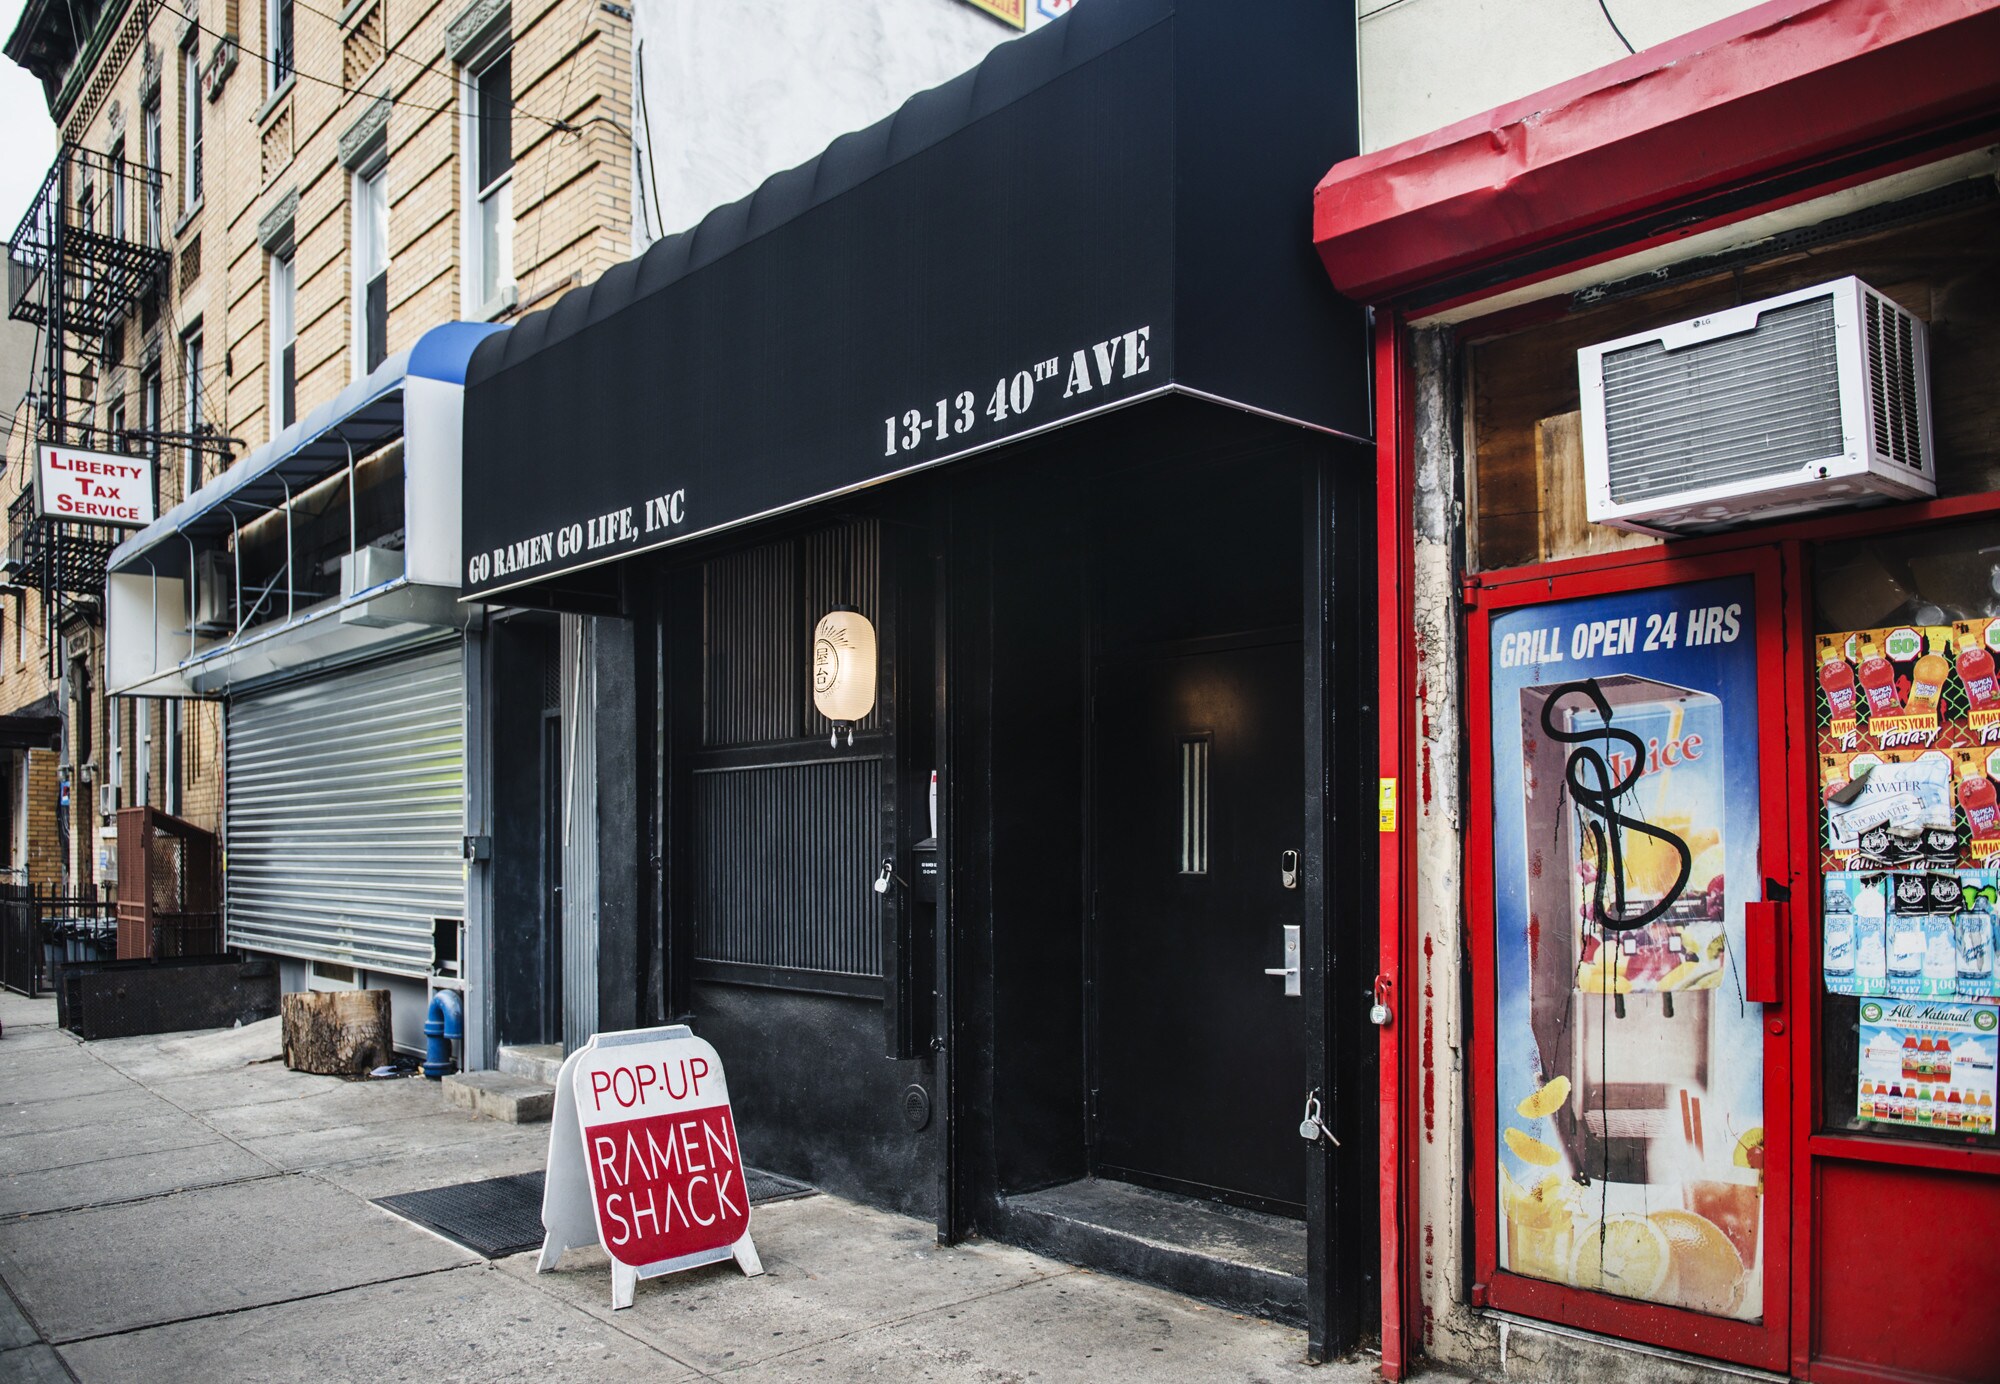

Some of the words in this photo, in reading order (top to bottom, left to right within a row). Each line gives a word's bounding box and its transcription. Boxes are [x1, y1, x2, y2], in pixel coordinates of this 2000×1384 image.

[1701, 318, 1711, 326] LG
[884, 390, 975, 456] 13-13
[1063, 325, 1150, 398] AVE
[50, 451, 142, 479] LIBERTY
[75, 477, 120, 500] TAX
[57, 493, 139, 520] SERVICE
[468, 552, 490, 584] GO
[493, 531, 554, 578] RAMEN
[557, 523, 583, 558] GO
[587, 506, 639, 549] LIFE,
[645, 488, 685, 533] INC
[1500, 626, 1564, 669] GRILL
[1571, 616, 1637, 661] OPEN
[1642, 611, 1679, 652] 24
[1685, 603, 1742, 647] HRS
[1908, 717, 1935, 731] YOUR
[1877, 726, 1942, 751] Fantasy
[1876, 780, 1921, 794] WATER
[1888, 1004, 1915, 1018] All
[1917, 1006, 1972, 1022] Natural
[594, 1116, 734, 1190] RAMEN
[606, 1169, 742, 1246] SHACK
